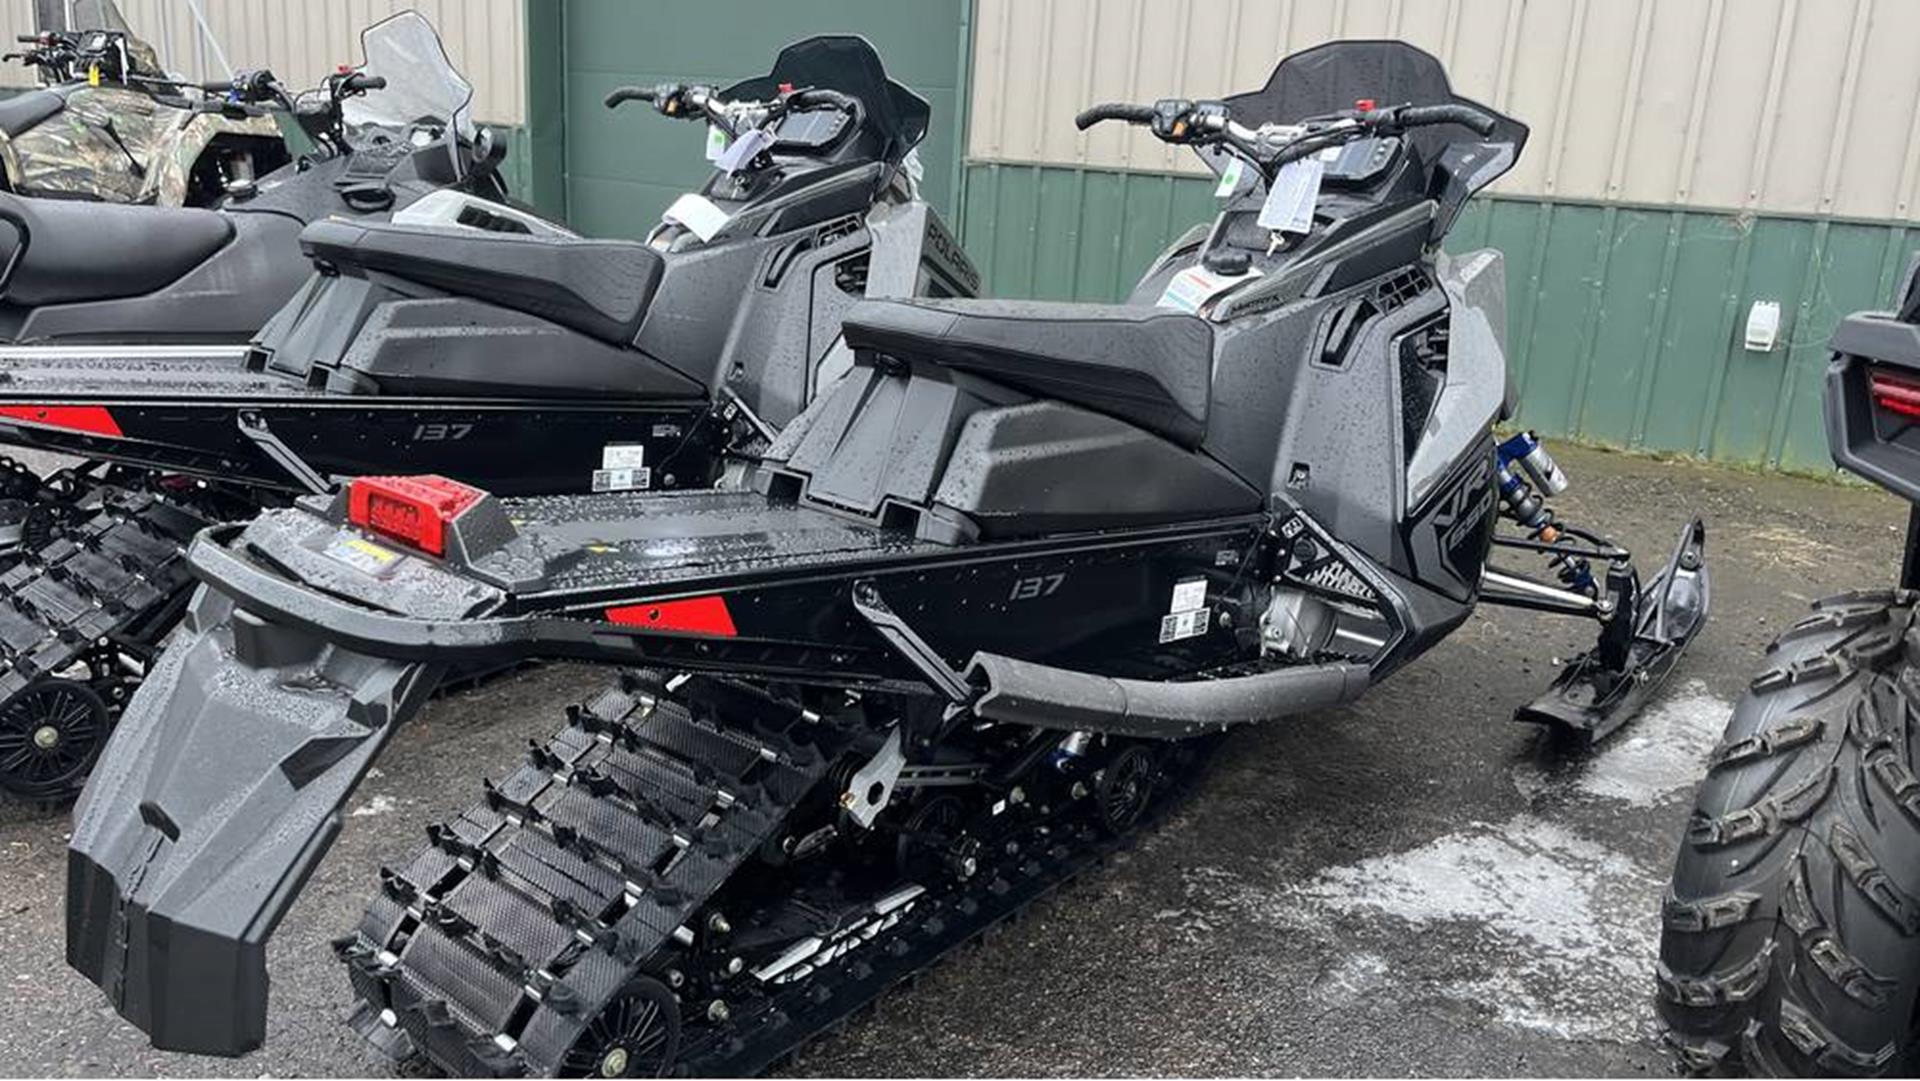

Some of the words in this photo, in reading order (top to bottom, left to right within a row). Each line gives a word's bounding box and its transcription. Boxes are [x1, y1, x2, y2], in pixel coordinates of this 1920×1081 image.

[928, 223, 979, 291] POLARIS
[414, 424, 473, 440] 137
[1449, 488, 1492, 551] 650
[1010, 573, 1066, 600] 137
